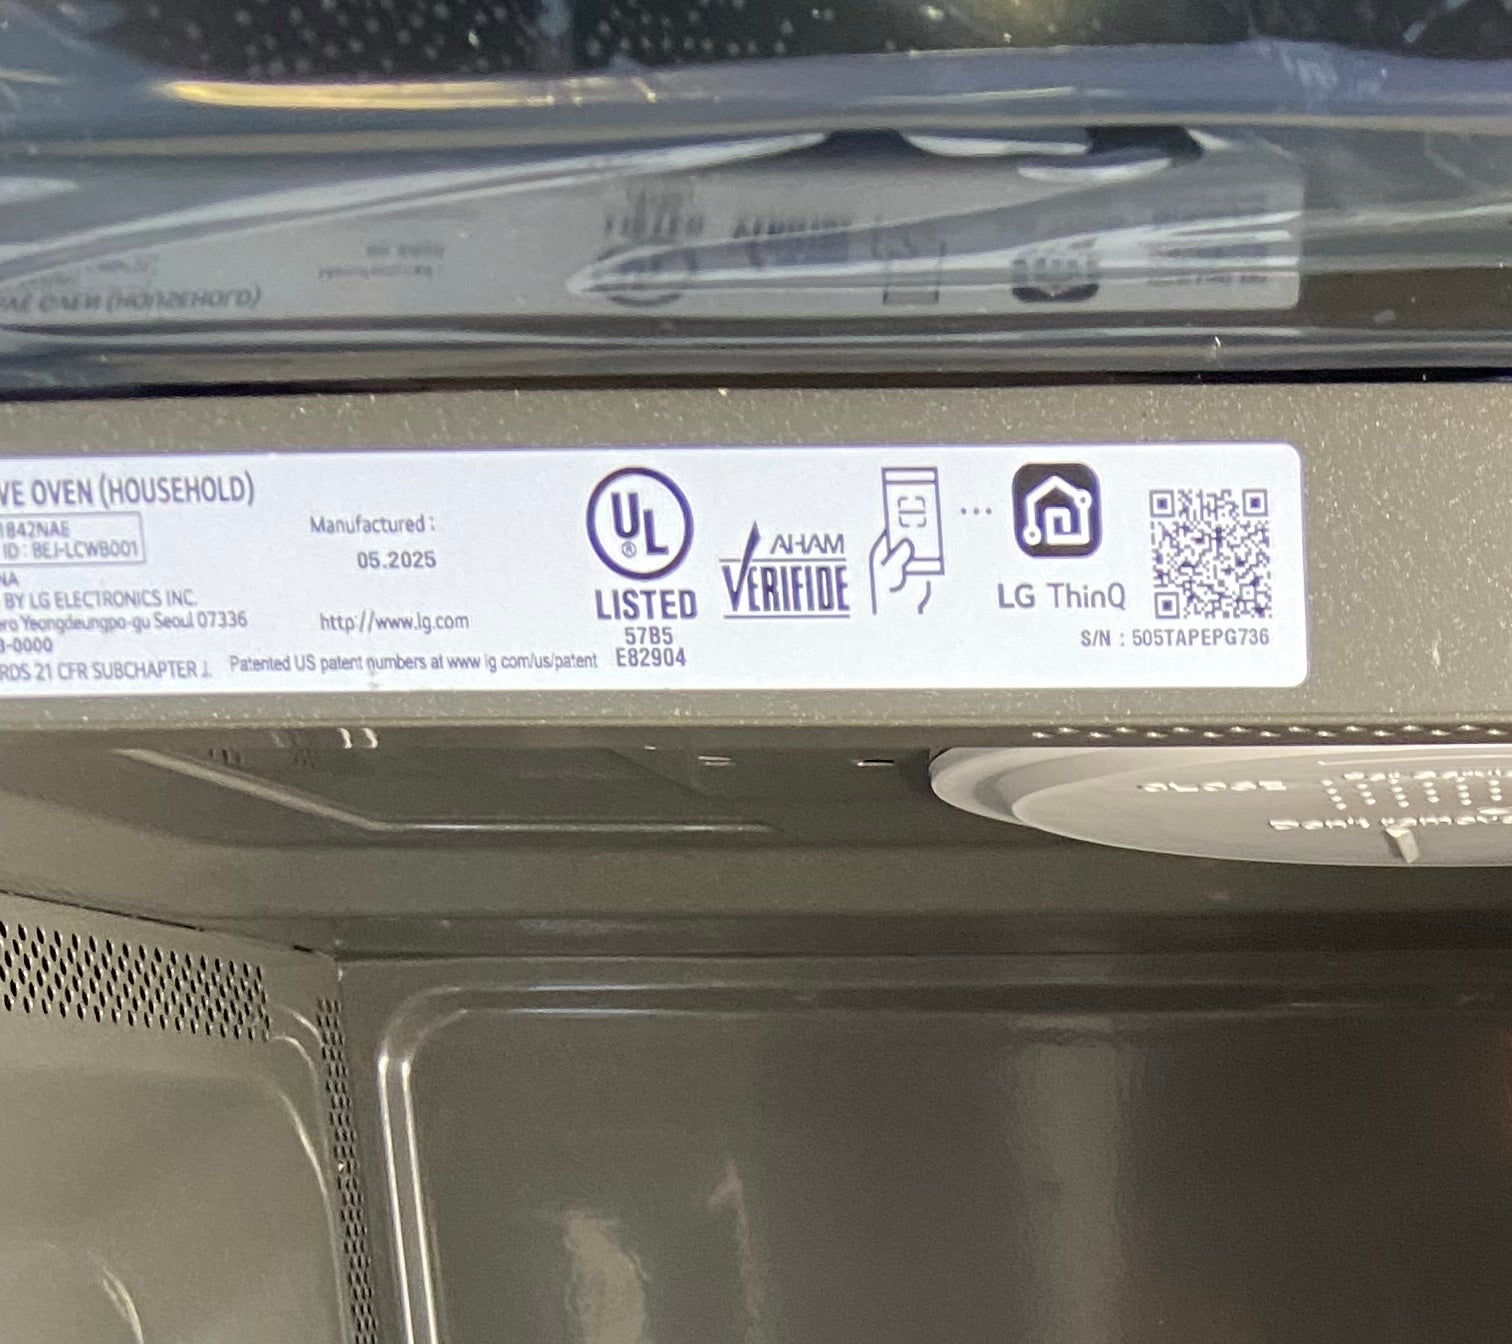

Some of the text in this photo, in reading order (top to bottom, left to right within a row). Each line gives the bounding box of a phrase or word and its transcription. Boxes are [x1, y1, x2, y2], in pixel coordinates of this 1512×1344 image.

[31, 478, 93, 505] OVEN
[100, 470, 254, 509] (HOUSEHOLD)
[309, 515, 426, 534] Manufactured
[611, 492, 669, 555] UL
[770, 534, 844, 554] AHAM
[358, 551, 436, 569] 05.2025
[30, 592, 50, 609] LG
[54, 590, 162, 608] ELECTRONICS
[595, 590, 698, 620] LISTED
[998, 582, 1126, 611] LG ThinQ
[154, 612, 193, 628] Seoul
[197, 611, 248, 628] 07336
[319, 611, 469, 634] http://www.lg.com
[1080, 629, 1111, 647] S/N
[1132, 628, 1270, 646] 505TAPEPG736
[294, 656, 316, 671] US
[320, 656, 362, 674] patent
[616, 649, 686, 667] E82904
[37, 663, 50, 680] 21
[58, 663, 88, 680] CFR
[93, 661, 197, 678] SUBCHAPTER
